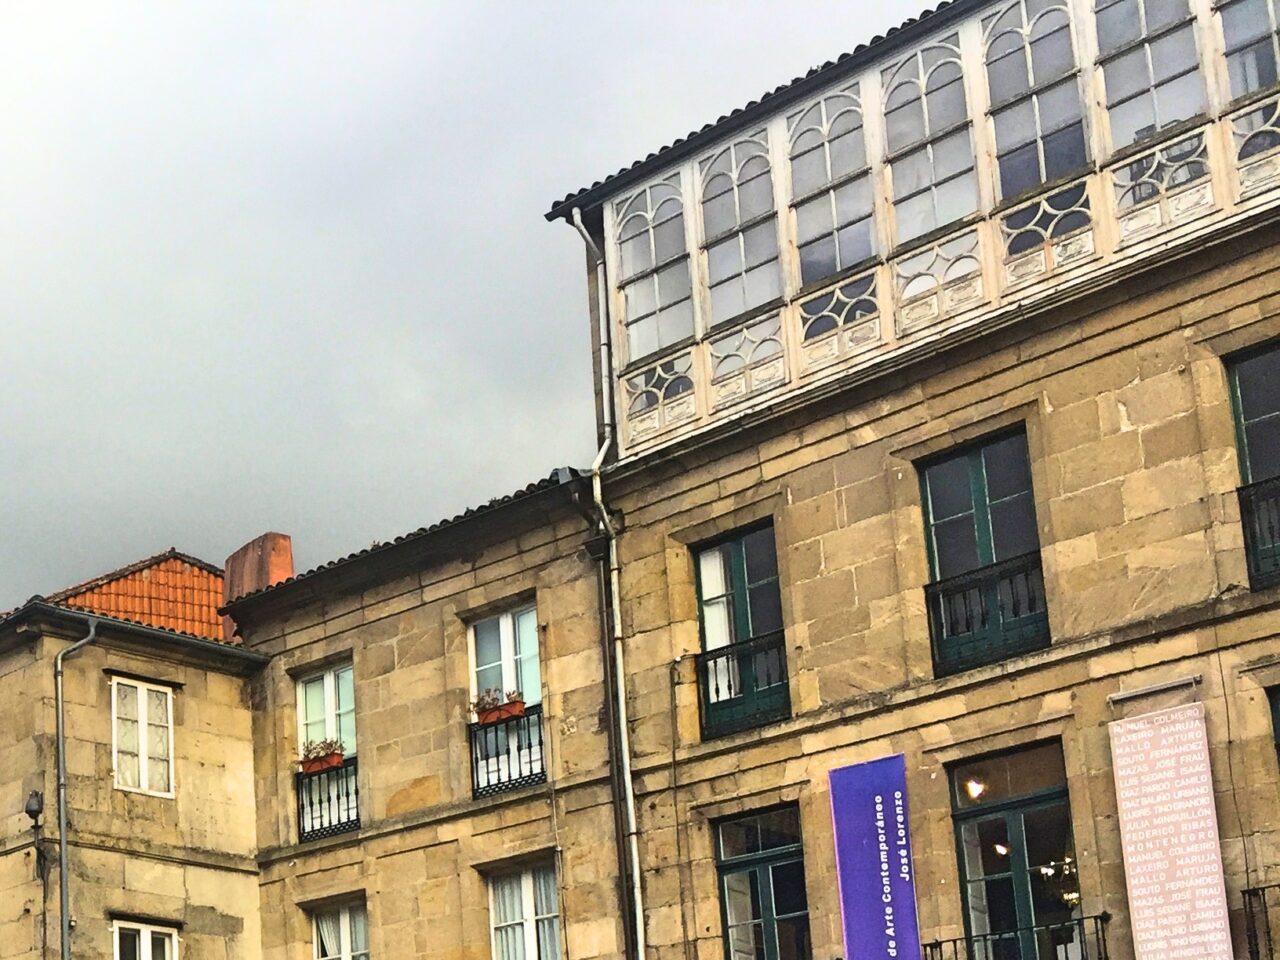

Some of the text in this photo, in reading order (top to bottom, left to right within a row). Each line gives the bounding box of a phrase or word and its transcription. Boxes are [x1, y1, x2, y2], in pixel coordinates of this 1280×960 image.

[1154, 708, 1198, 724] COLMEIRO
[1161, 719, 1200, 733] MARUJA
[1116, 731, 1201, 753] MALLO ARTURO
[1175, 775, 1207, 787] CAMILO
[1126, 818, 1150, 829] JULIA
[1126, 819, 1213, 841] FEDERICO RIBAS
[894, 791, 910, 882] José Lorenzo
[1127, 830, 1214, 852] MONTENEGRO
[874, 795, 892, 903] Contemporáneo
[1128, 841, 1215, 863] MANUEL COLMEIRO
[1129, 852, 1217, 874] LAXEIRO MARUJA
[1131, 864, 1218, 884] MALLO ARTURO
[884, 906, 896, 937] Arte
[1190, 910, 1224, 921] CAMILO
[887, 940, 897, 957] de
